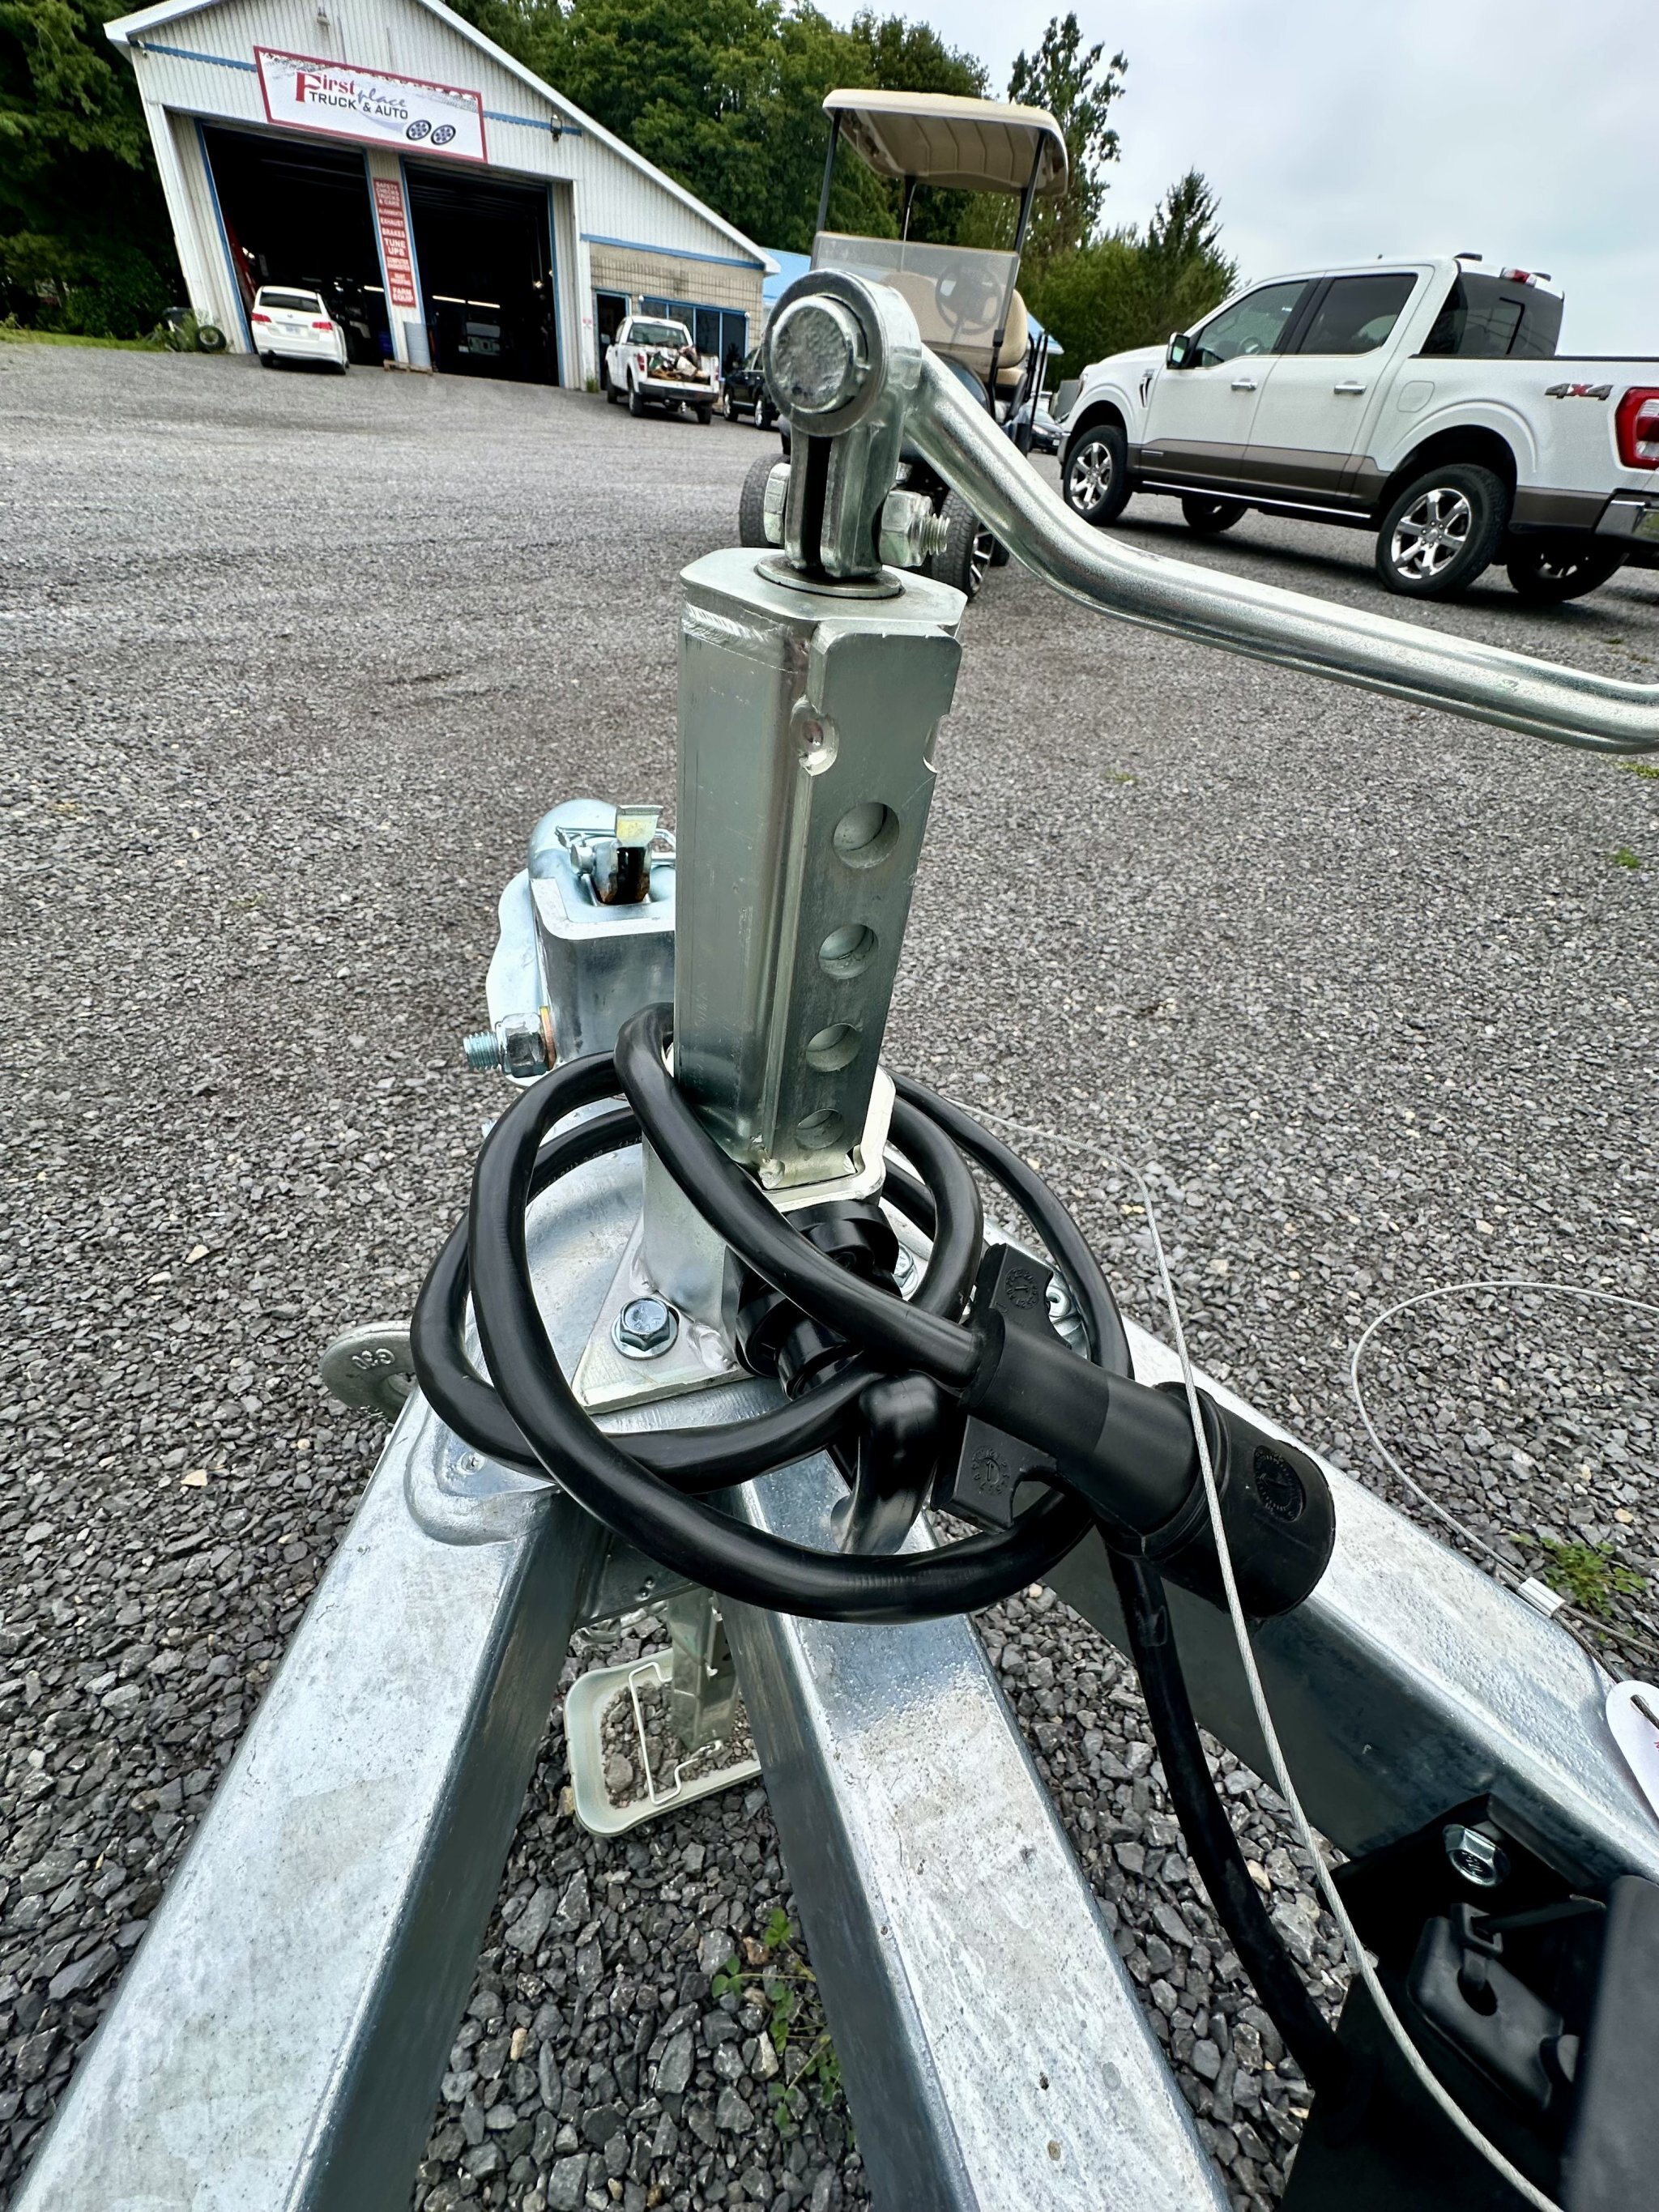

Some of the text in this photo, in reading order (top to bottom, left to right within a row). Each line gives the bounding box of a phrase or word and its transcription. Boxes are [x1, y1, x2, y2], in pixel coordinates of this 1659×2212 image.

[296, 71, 407, 108] First place
[309, 91, 408, 119] TRUCK & AUTO
[382, 228, 405, 238] BRAKES
[384, 237, 406, 249] TUNE
[388, 246, 404, 256] UPS
